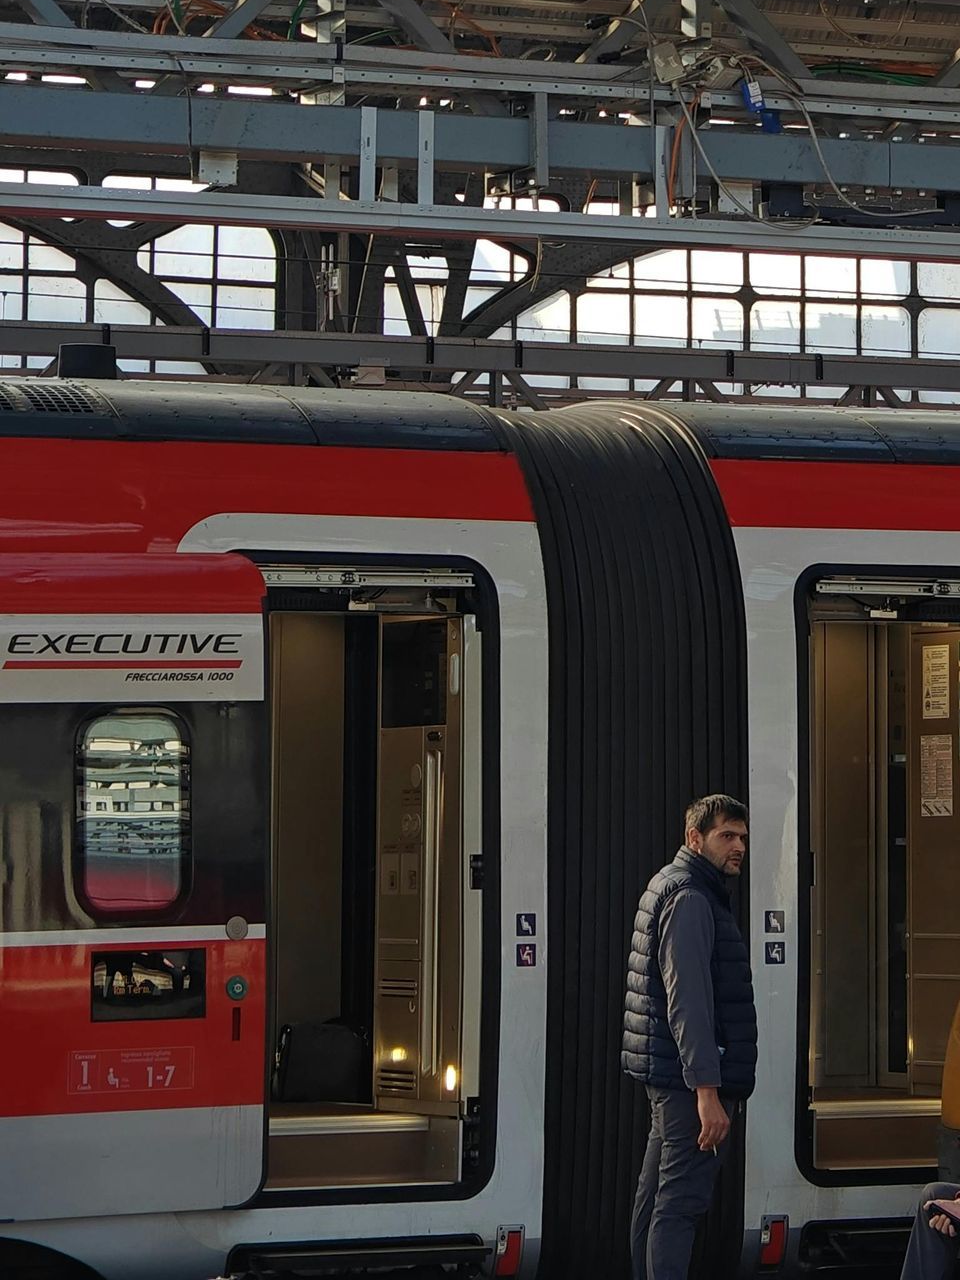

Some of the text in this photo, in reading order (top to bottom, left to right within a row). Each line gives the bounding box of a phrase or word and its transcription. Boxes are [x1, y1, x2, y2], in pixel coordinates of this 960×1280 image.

[7, 633, 243, 654] EXECUTIVE
[125, 672, 234, 682] FRECCIAROSSA 1000
[81, 1060, 89, 1085] 1
[146, 1065, 176, 1088] 1-7
